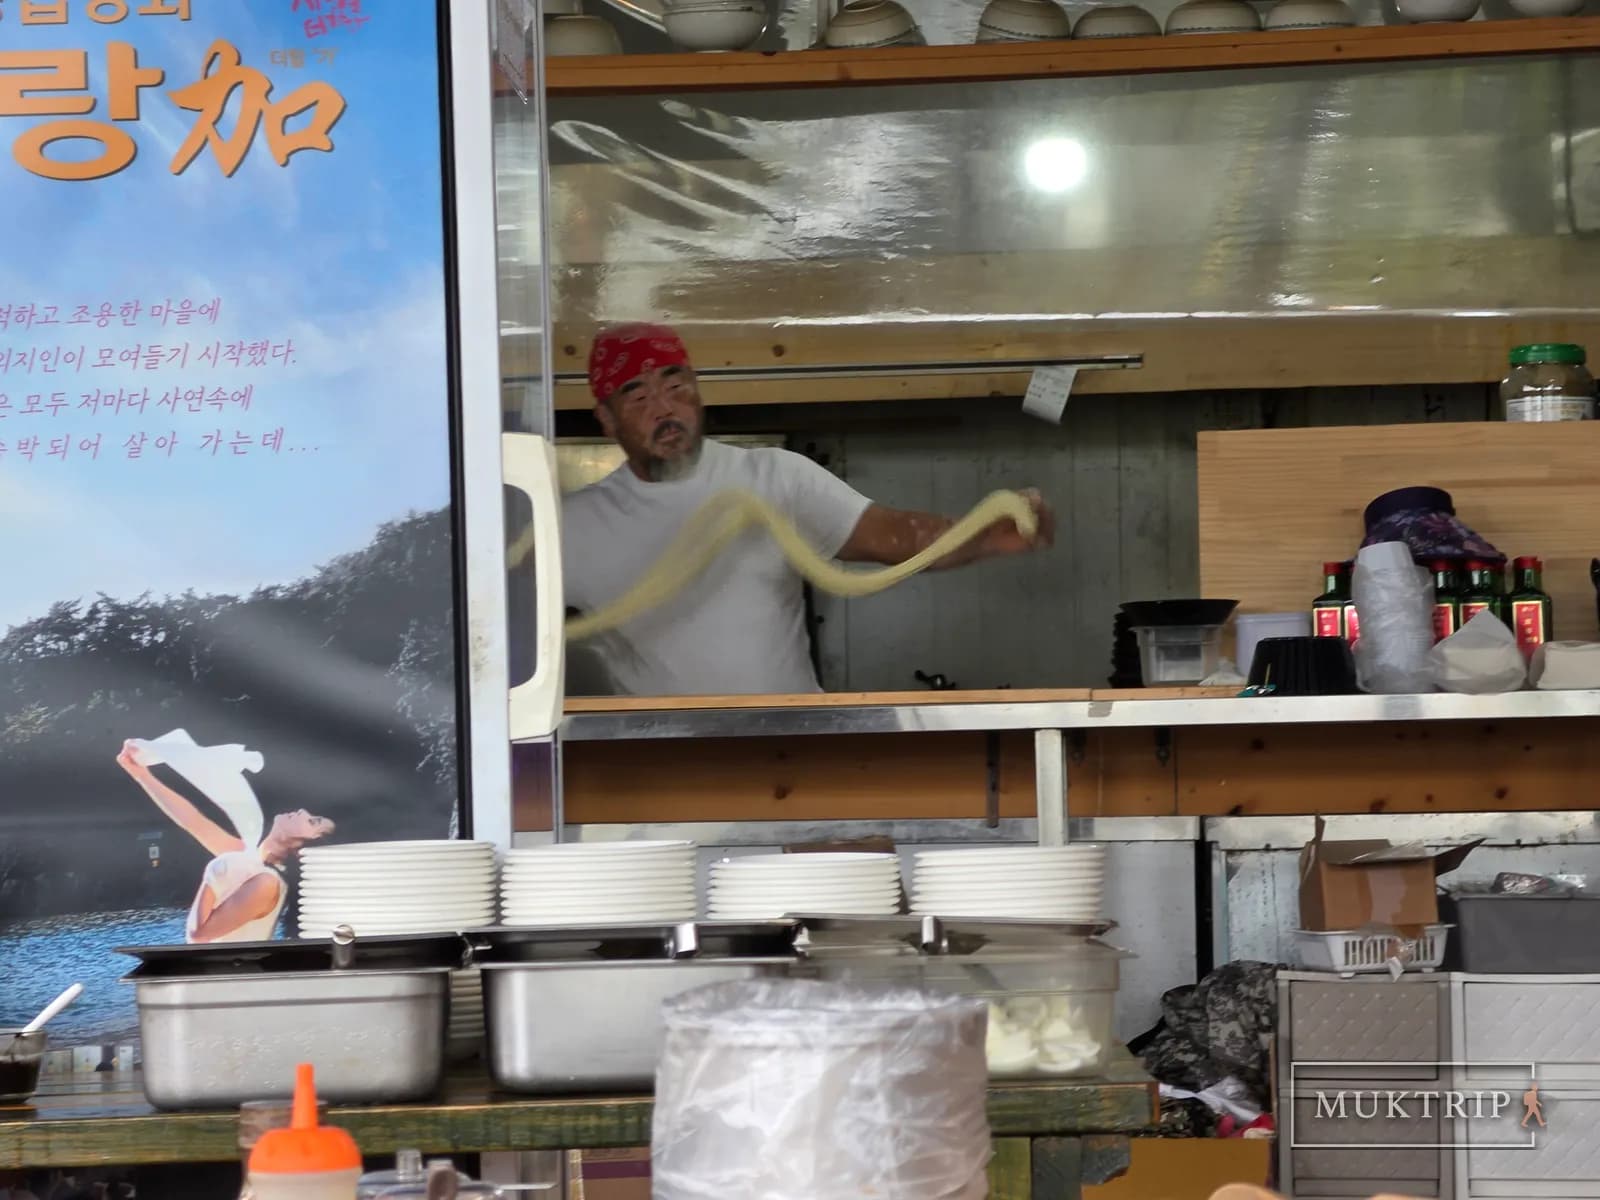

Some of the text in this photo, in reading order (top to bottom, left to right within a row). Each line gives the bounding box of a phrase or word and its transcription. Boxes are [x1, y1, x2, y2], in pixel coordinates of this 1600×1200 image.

[66, 300, 143, 328] 조용한
[150, 297, 221, 327] 마을에
[91, 342, 190, 370] 모여들기
[198, 338, 297, 368] 시작했다.
[19, 392, 70, 416] 모두
[77, 387, 149, 415] 저마다
[156, 383, 254, 413] 사연속에
[122, 430, 179, 459] 살아
